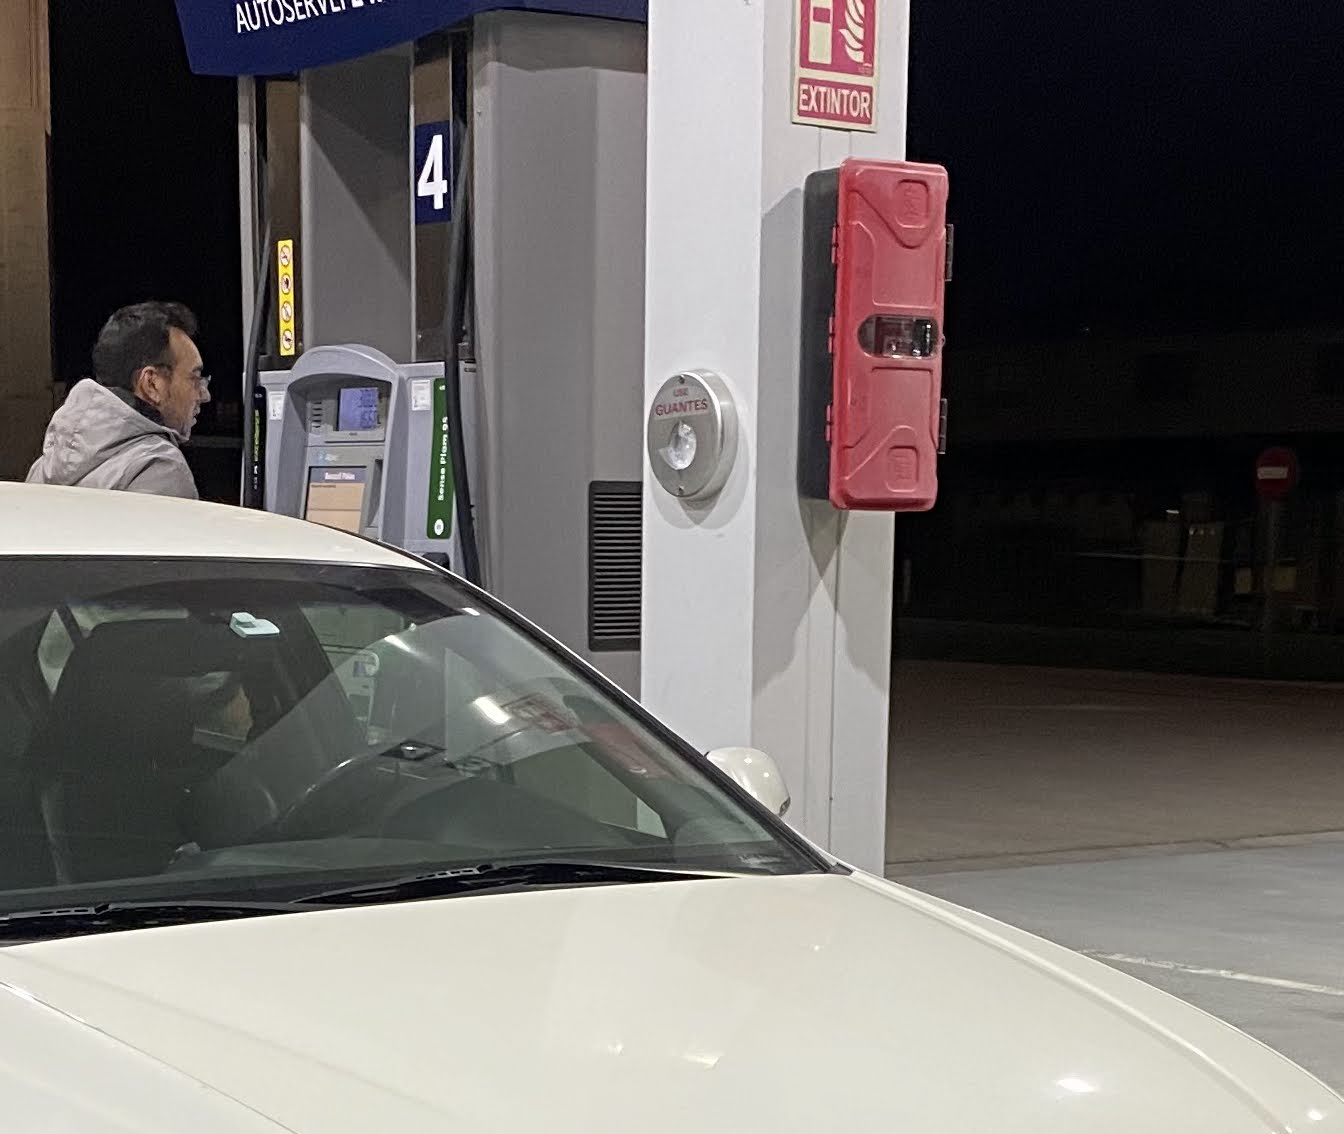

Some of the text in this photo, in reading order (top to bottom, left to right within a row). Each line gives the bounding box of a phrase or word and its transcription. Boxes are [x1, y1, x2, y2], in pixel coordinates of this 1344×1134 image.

[798, 83, 871, 119] EXTINTOR
[417, 134, 448, 210] 4
[655, 399, 708, 416] GUANTES
